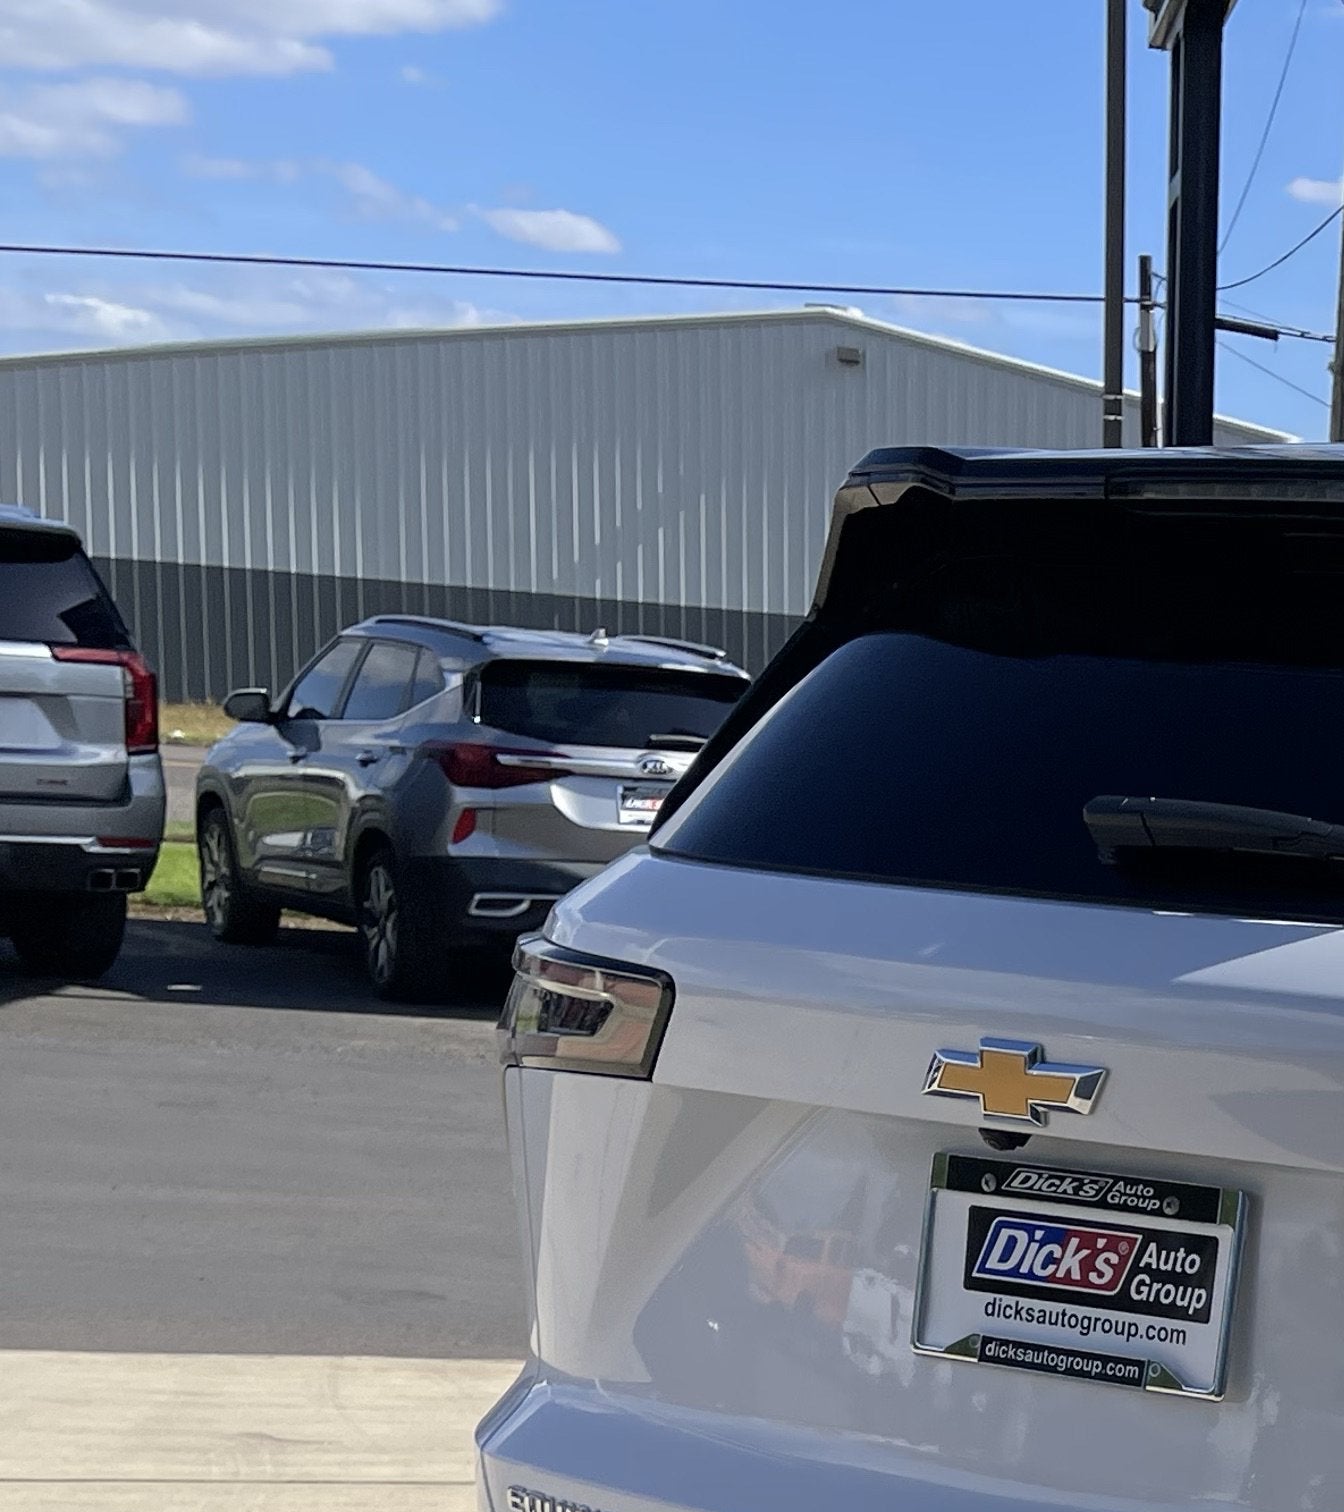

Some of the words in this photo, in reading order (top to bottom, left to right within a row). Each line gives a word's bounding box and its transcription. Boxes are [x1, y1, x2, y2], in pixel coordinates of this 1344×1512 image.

[1010, 1170, 1102, 1197] Dick's
[1106, 1191, 1161, 1211] Group
[1114, 1181, 1155, 1198] Auto
[984, 1227, 1120, 1286] Dick's
[1139, 1242, 1201, 1275] Auto
[1129, 1273, 1208, 1315] Group
[984, 1297, 1188, 1347] dicksautogroup.com
[984, 1340, 1140, 1380] dicksautogroup.com
